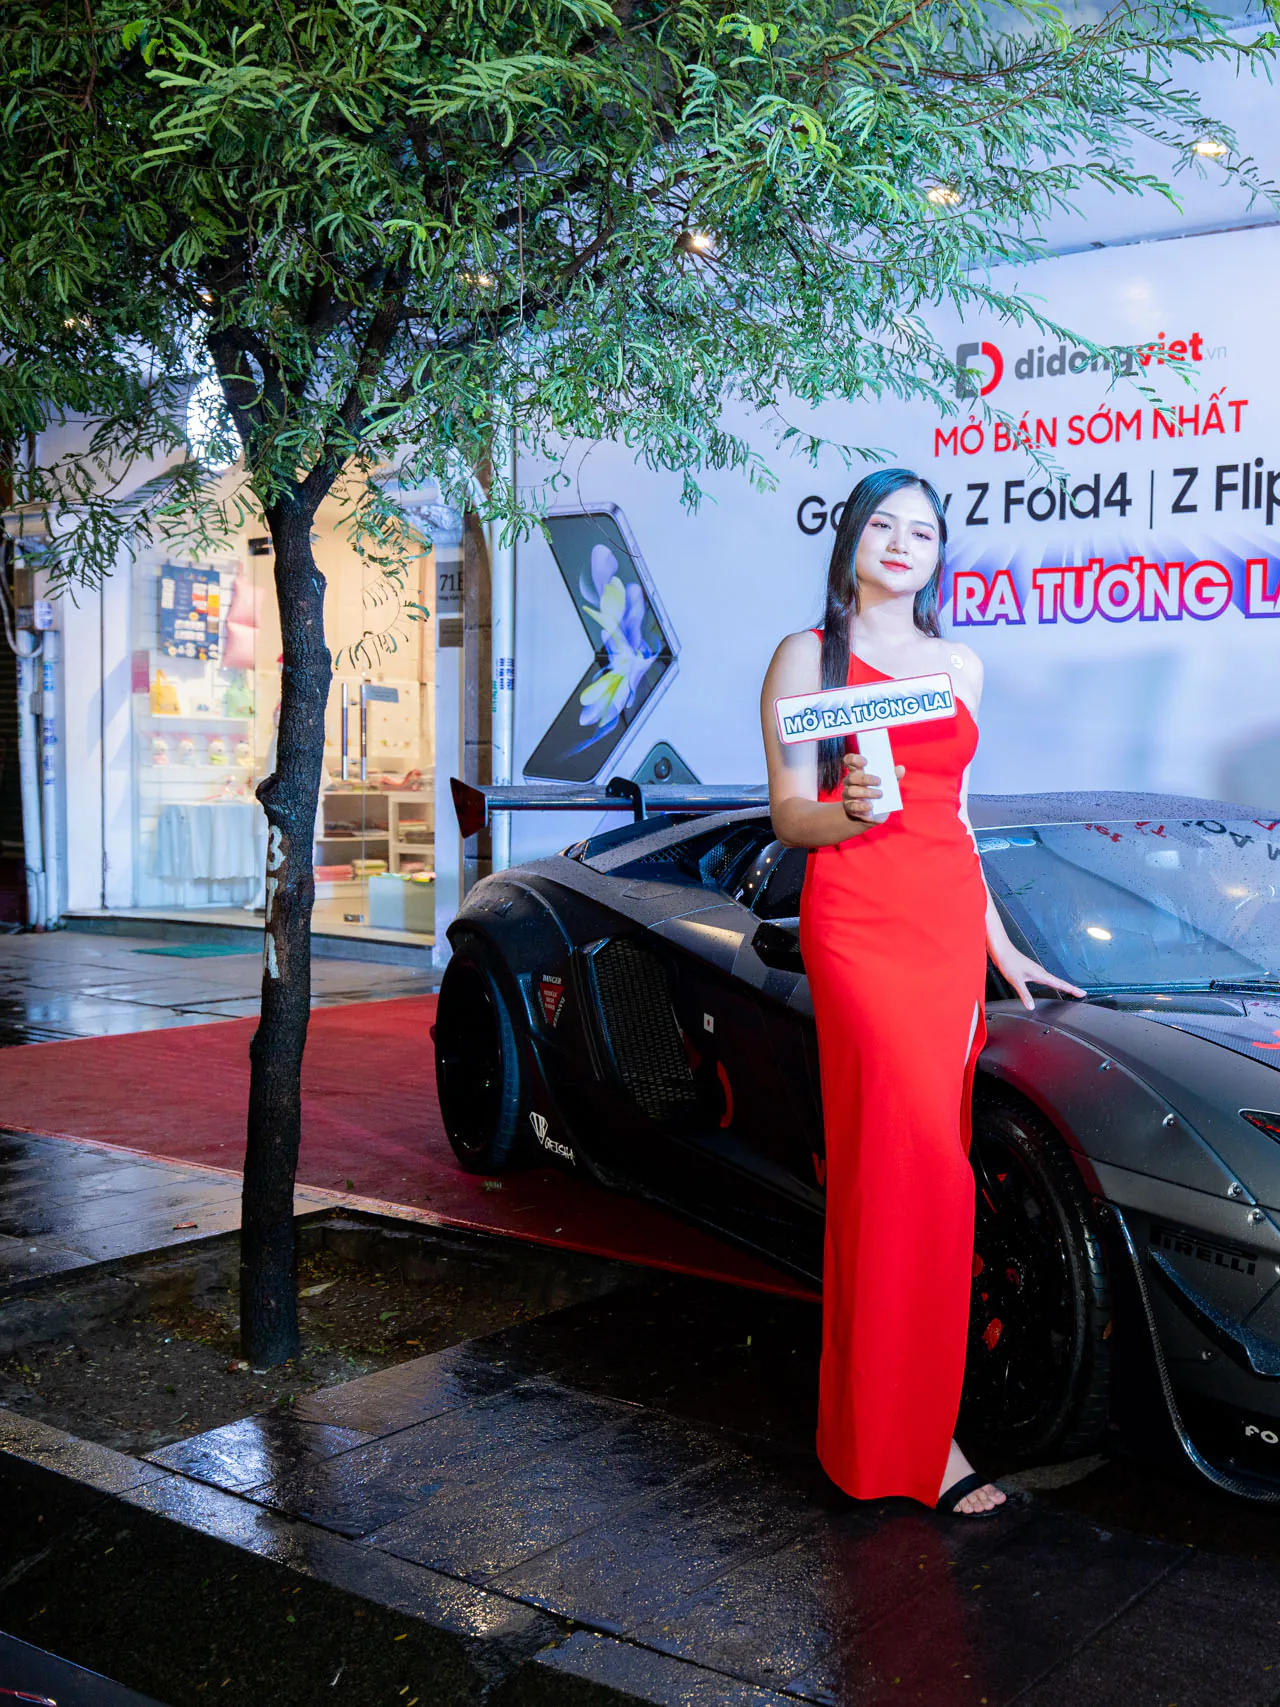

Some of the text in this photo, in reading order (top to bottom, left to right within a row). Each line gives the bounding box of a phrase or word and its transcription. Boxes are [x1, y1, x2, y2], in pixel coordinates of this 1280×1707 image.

[933, 386, 1249, 456] MỞ BÁN SỚM NHẤT
[965, 483, 990, 526] Z
[1004, 472, 1132, 524] Fold4
[1171, 467, 1199, 514] Z
[952, 569, 1026, 627] RA
[1032, 556, 1233, 625] TƯƠNG
[784, 691, 952, 735] MỞ RA TƯƠNG LAI
